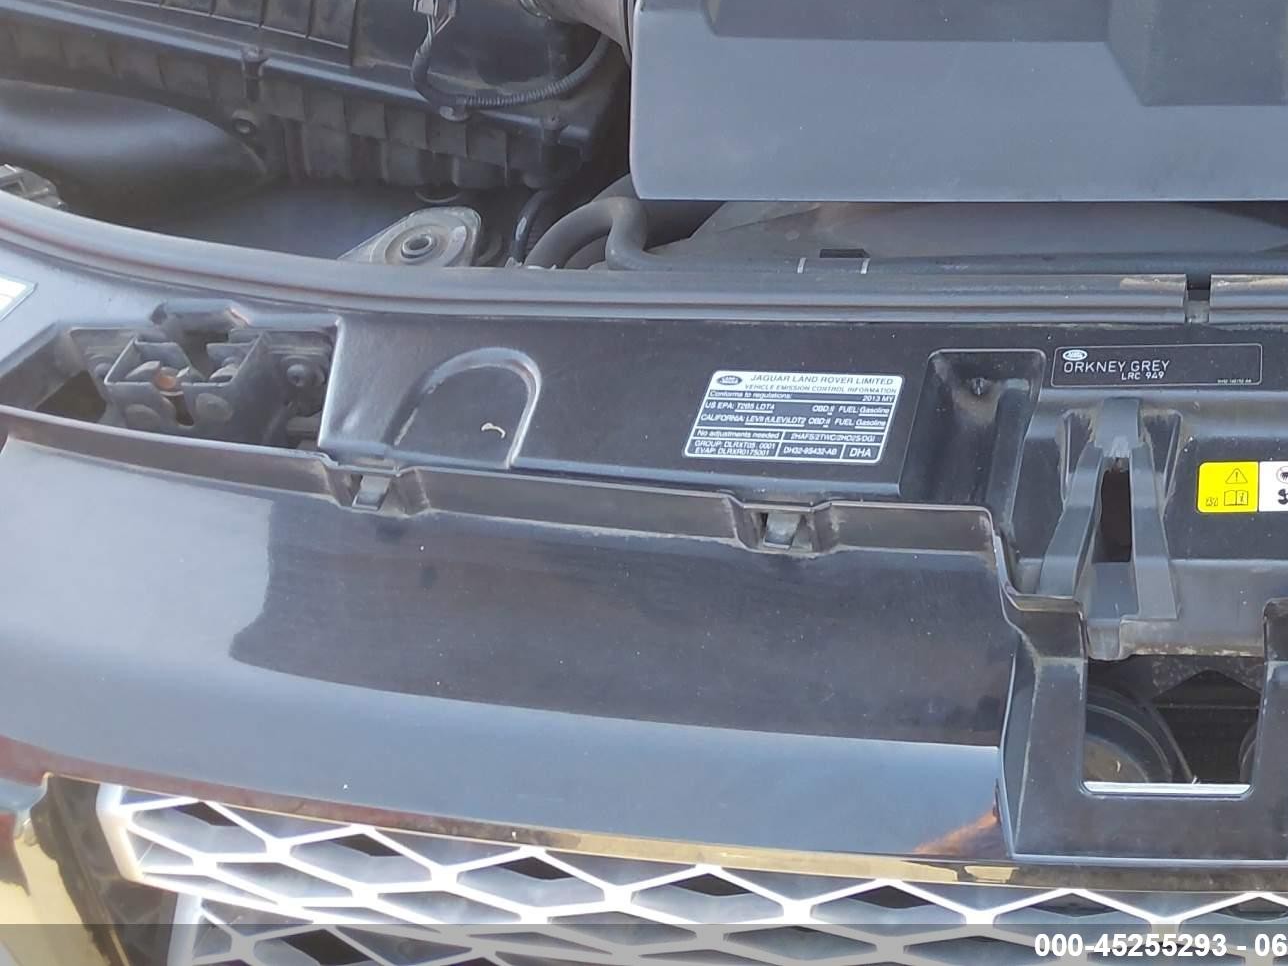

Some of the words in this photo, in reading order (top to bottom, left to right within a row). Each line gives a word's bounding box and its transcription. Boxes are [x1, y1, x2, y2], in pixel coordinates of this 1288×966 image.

[1063, 360, 1126, 373] ORKNEY
[1130, 360, 1170, 372] GREY
[750, 374, 791, 382] JAGUAR
[792, 375, 818, 383] LAND
[820, 376, 853, 384] ROVER
[856, 377, 893, 385] LIMITED
[1121, 371, 1141, 381] LRC
[1145, 370, 1165, 379] 949
[705, 401, 716, 409] US
[849, 448, 872, 457] DHA
